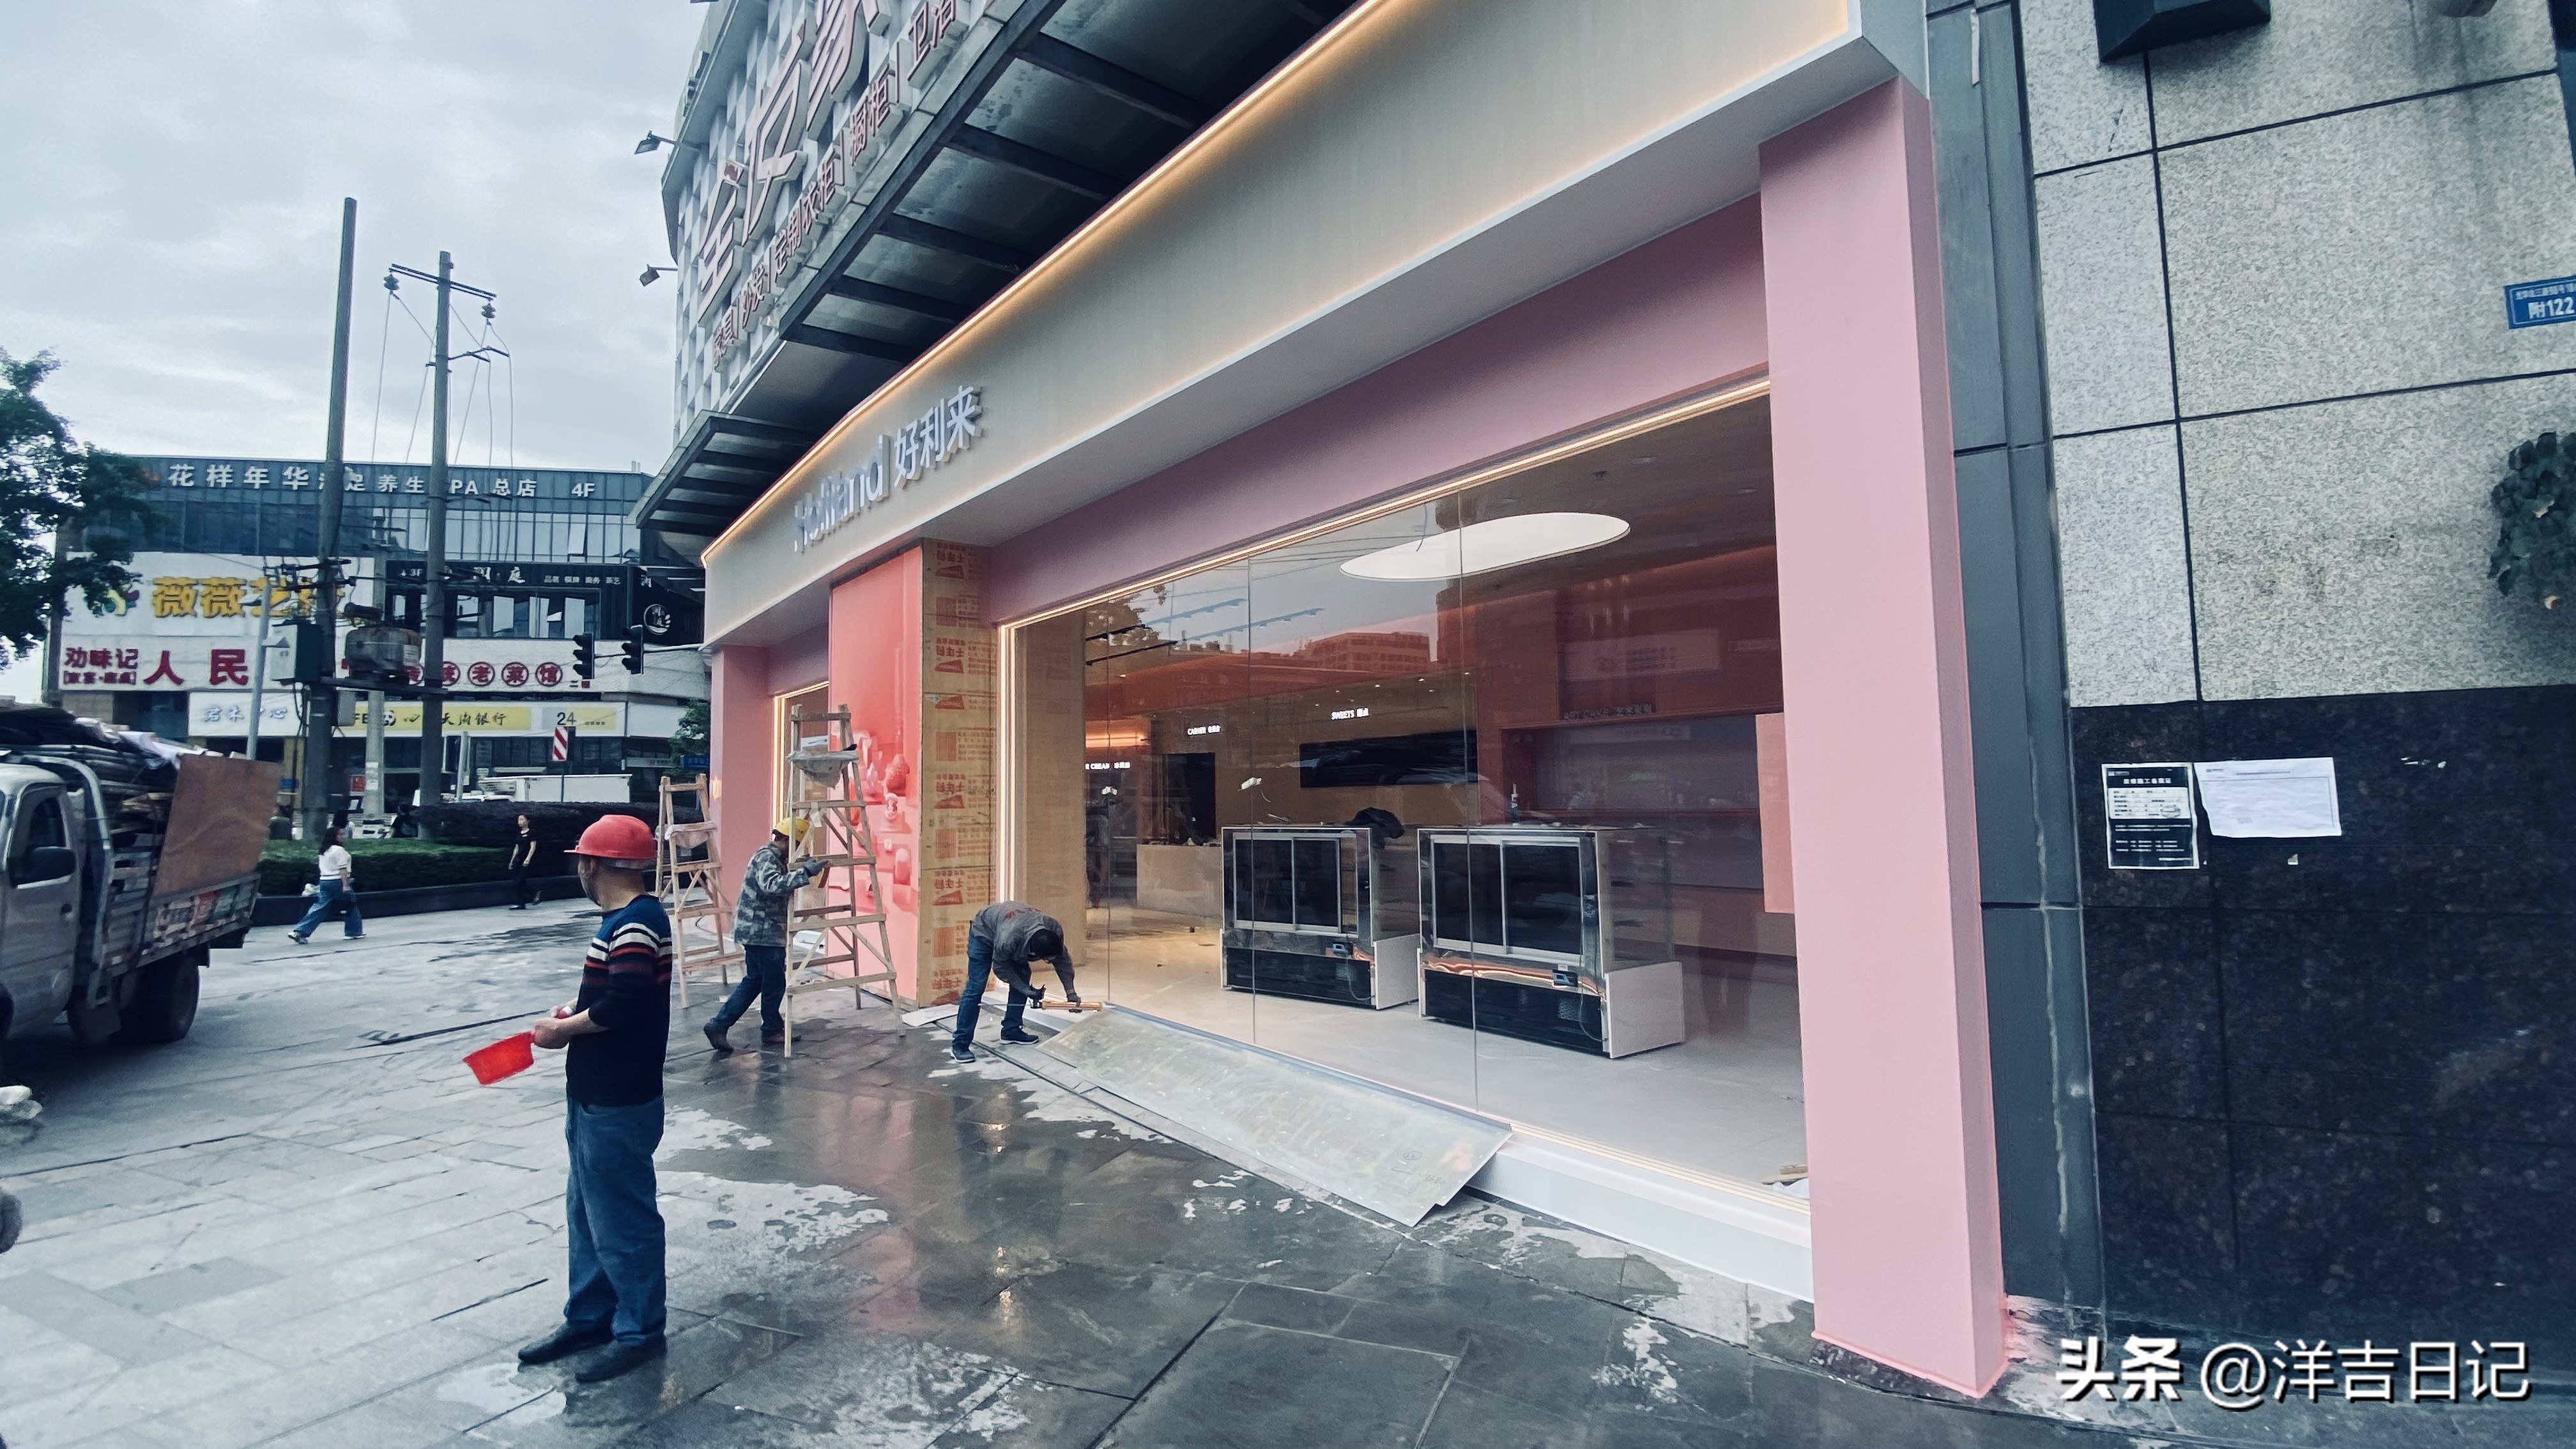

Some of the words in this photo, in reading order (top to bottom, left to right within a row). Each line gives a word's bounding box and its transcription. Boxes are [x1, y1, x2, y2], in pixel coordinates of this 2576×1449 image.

[894, 385, 976, 487] 好利来
[571, 482, 595, 498] 4F
[142, 649, 249, 686] 人民
[557, 712, 576, 725] 24
